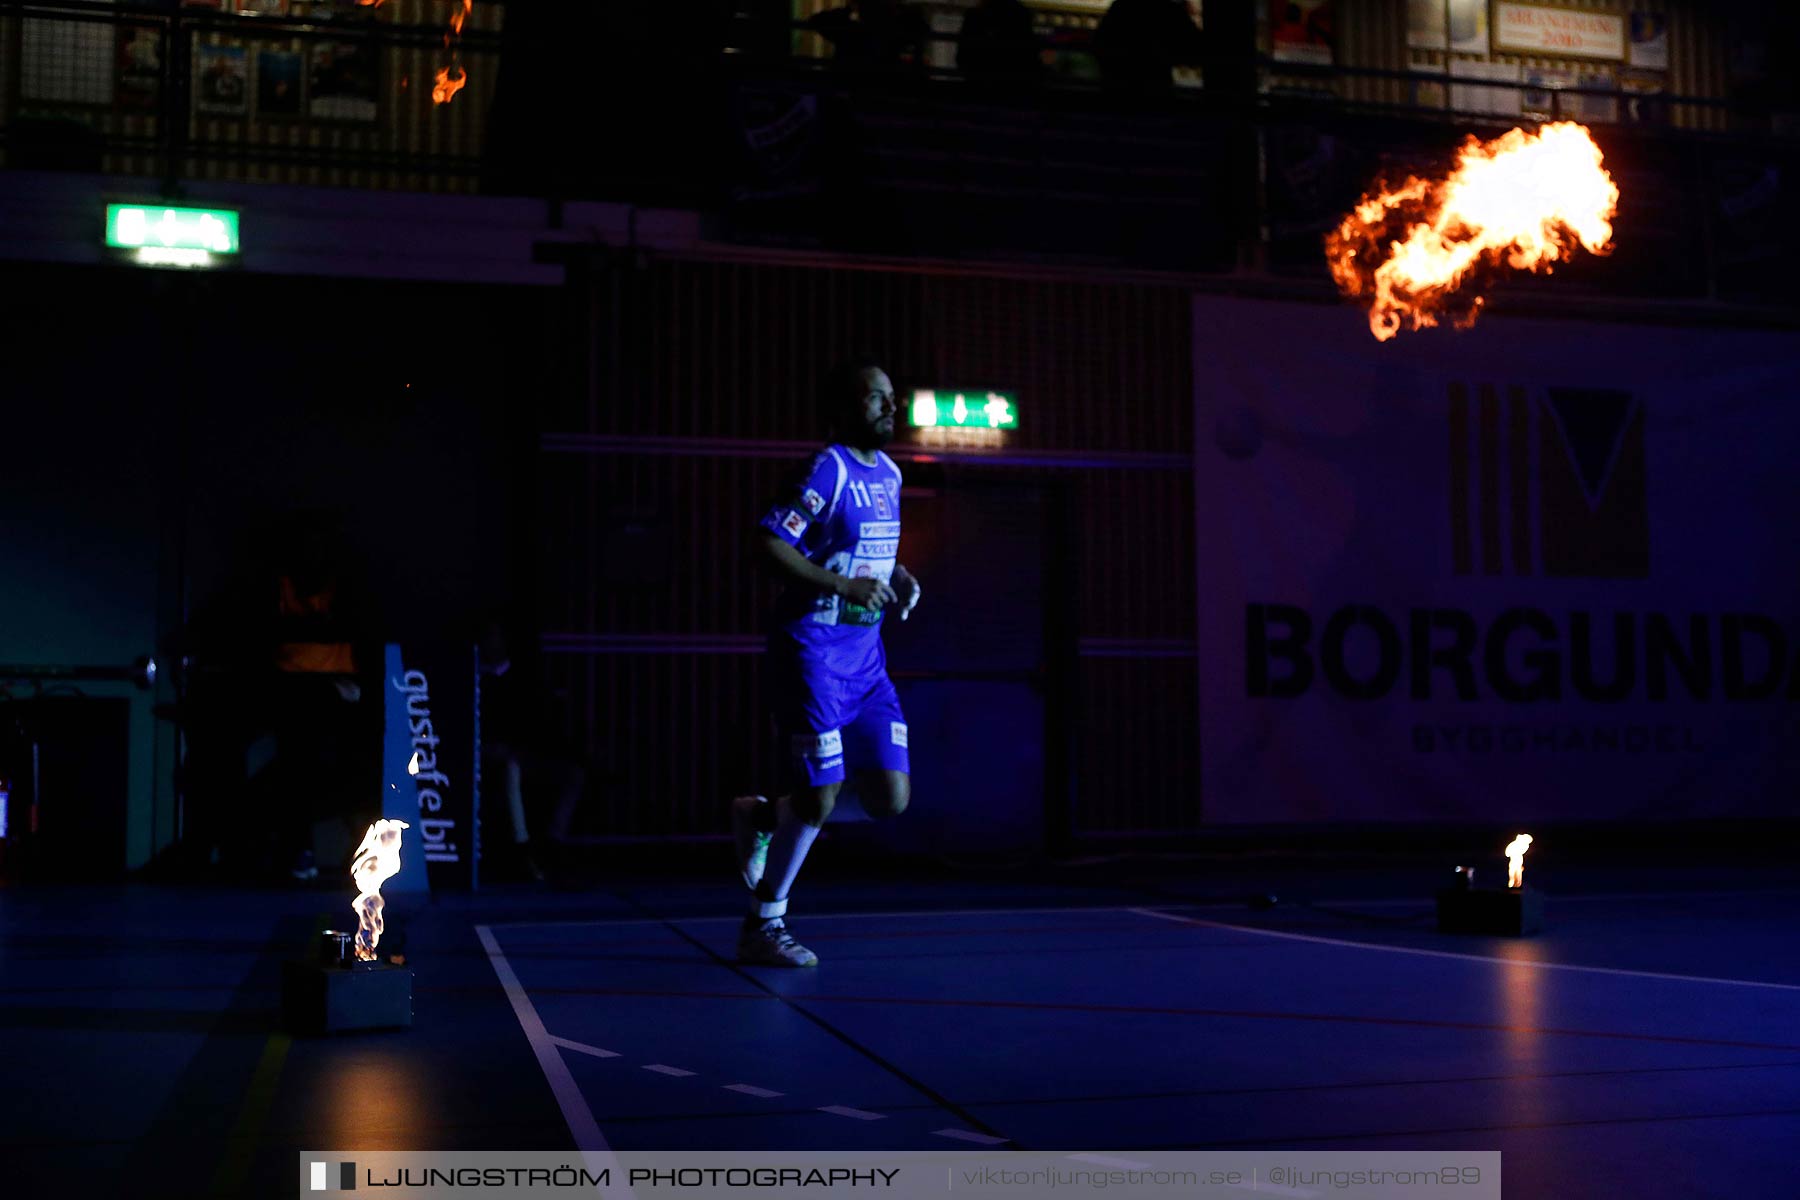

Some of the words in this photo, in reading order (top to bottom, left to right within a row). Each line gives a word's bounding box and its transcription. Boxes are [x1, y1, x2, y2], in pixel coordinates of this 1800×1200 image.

[848, 480, 872, 508] 11
[1245, 602, 1800, 702] BORGUND
[1411, 720, 1707, 754] BYGGHANDEL
